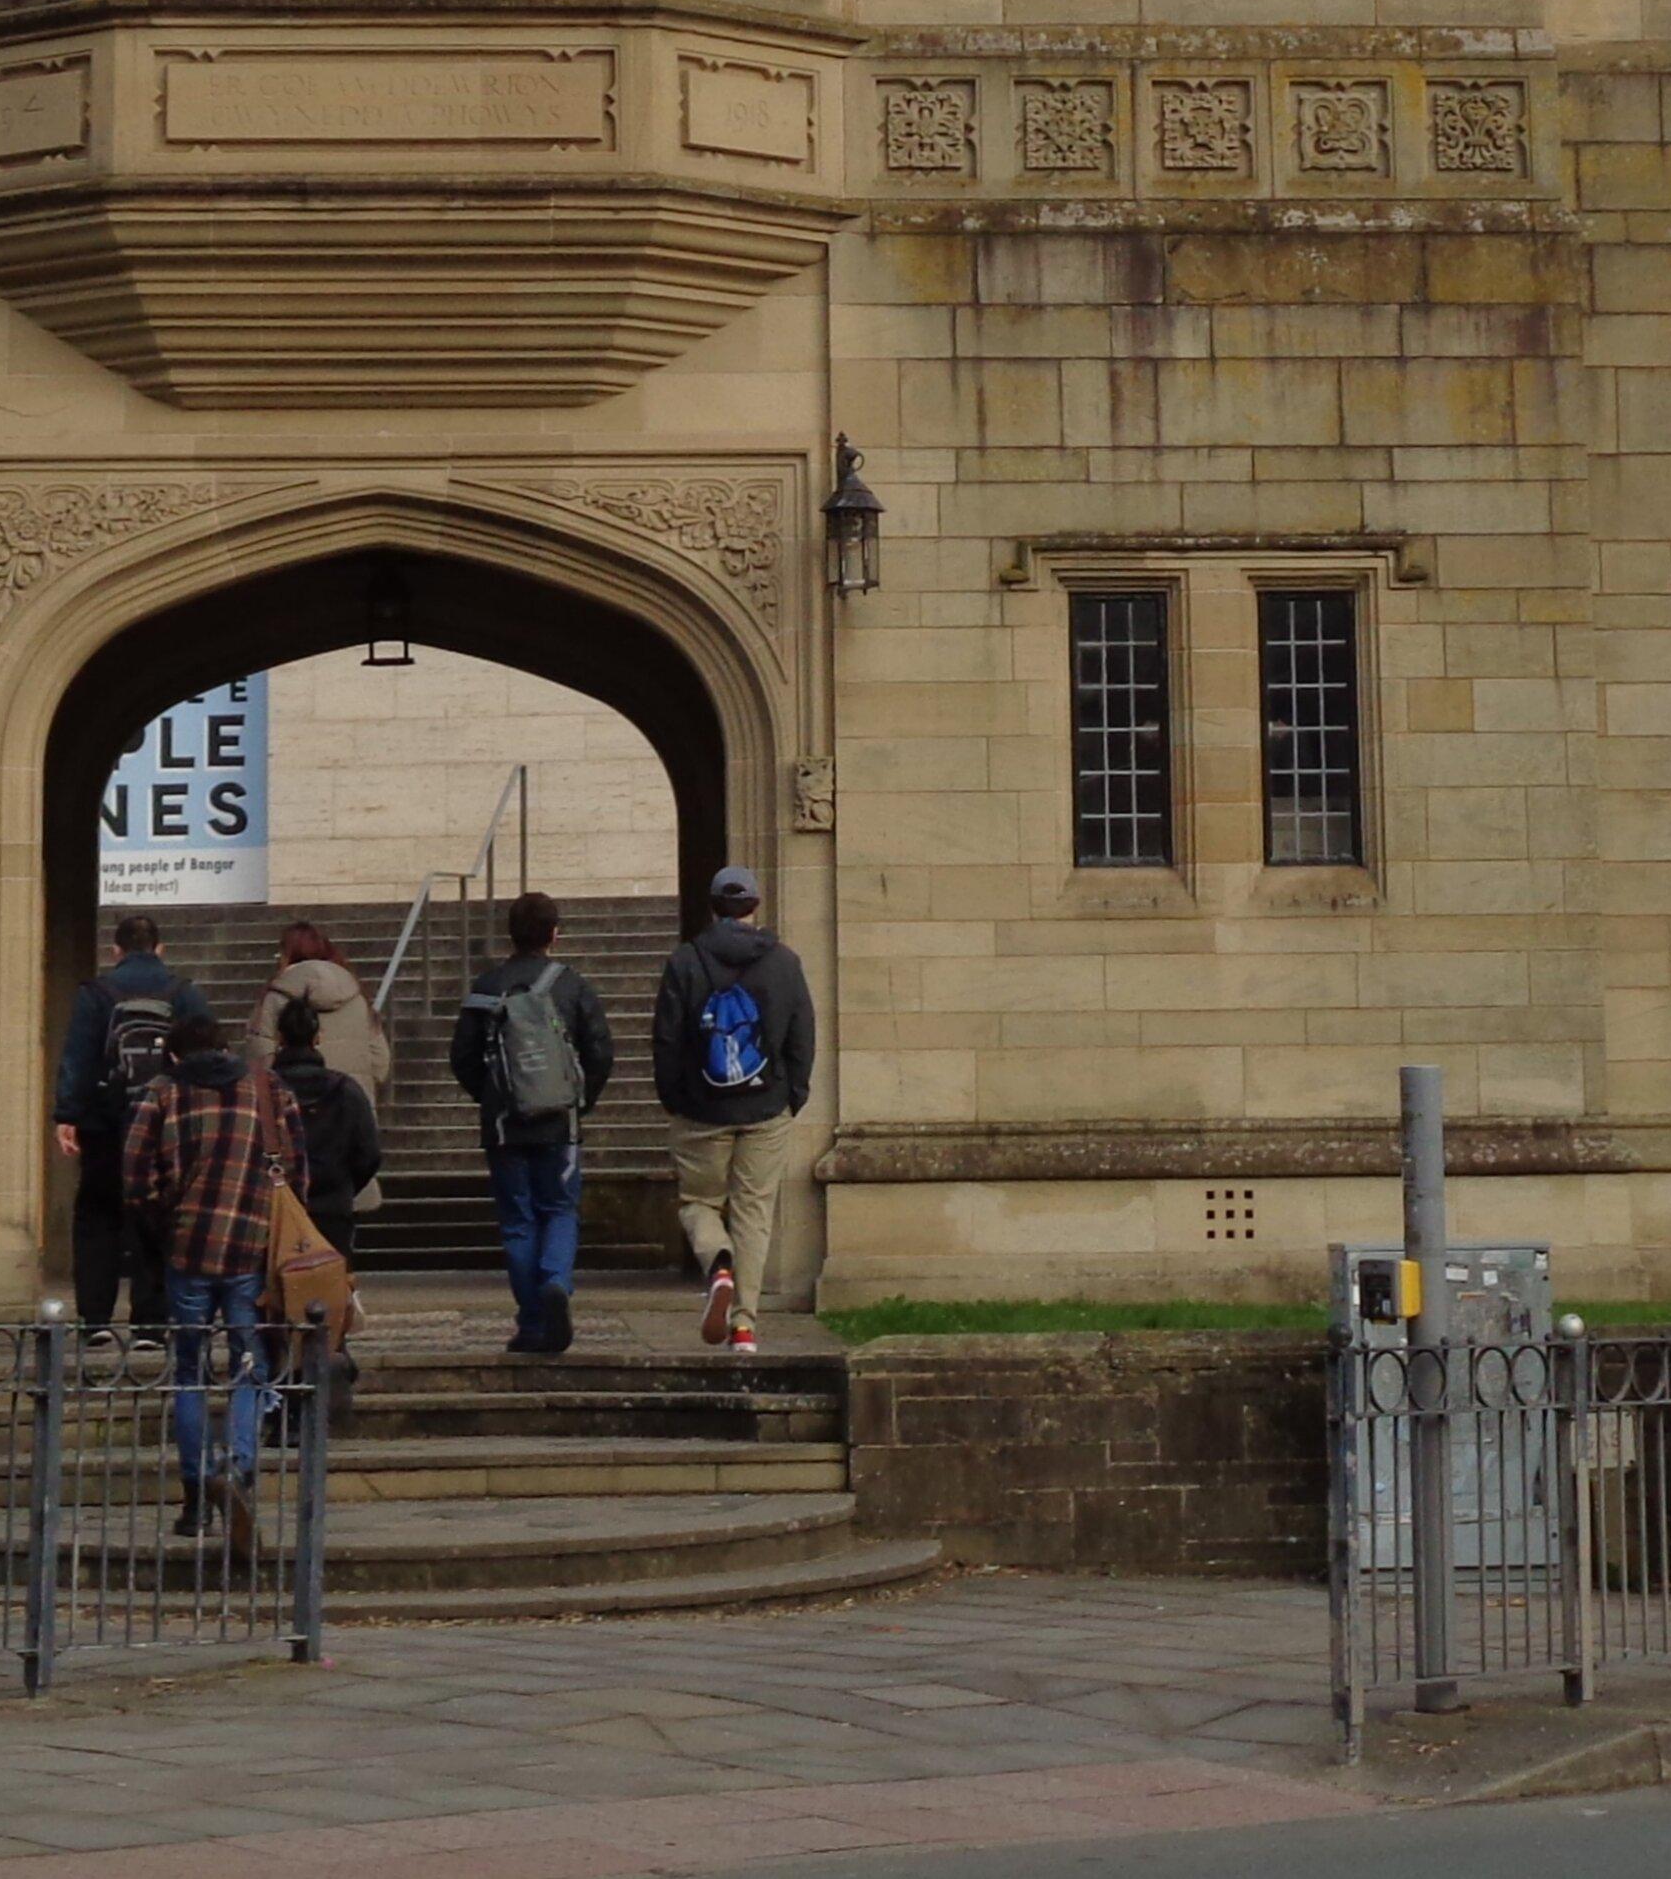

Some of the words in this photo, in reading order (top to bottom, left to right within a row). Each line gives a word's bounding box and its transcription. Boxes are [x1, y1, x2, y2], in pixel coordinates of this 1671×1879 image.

[128, 858, 170, 876] people
[173, 858, 186, 872] of
[189, 857, 235, 875] Bangor
